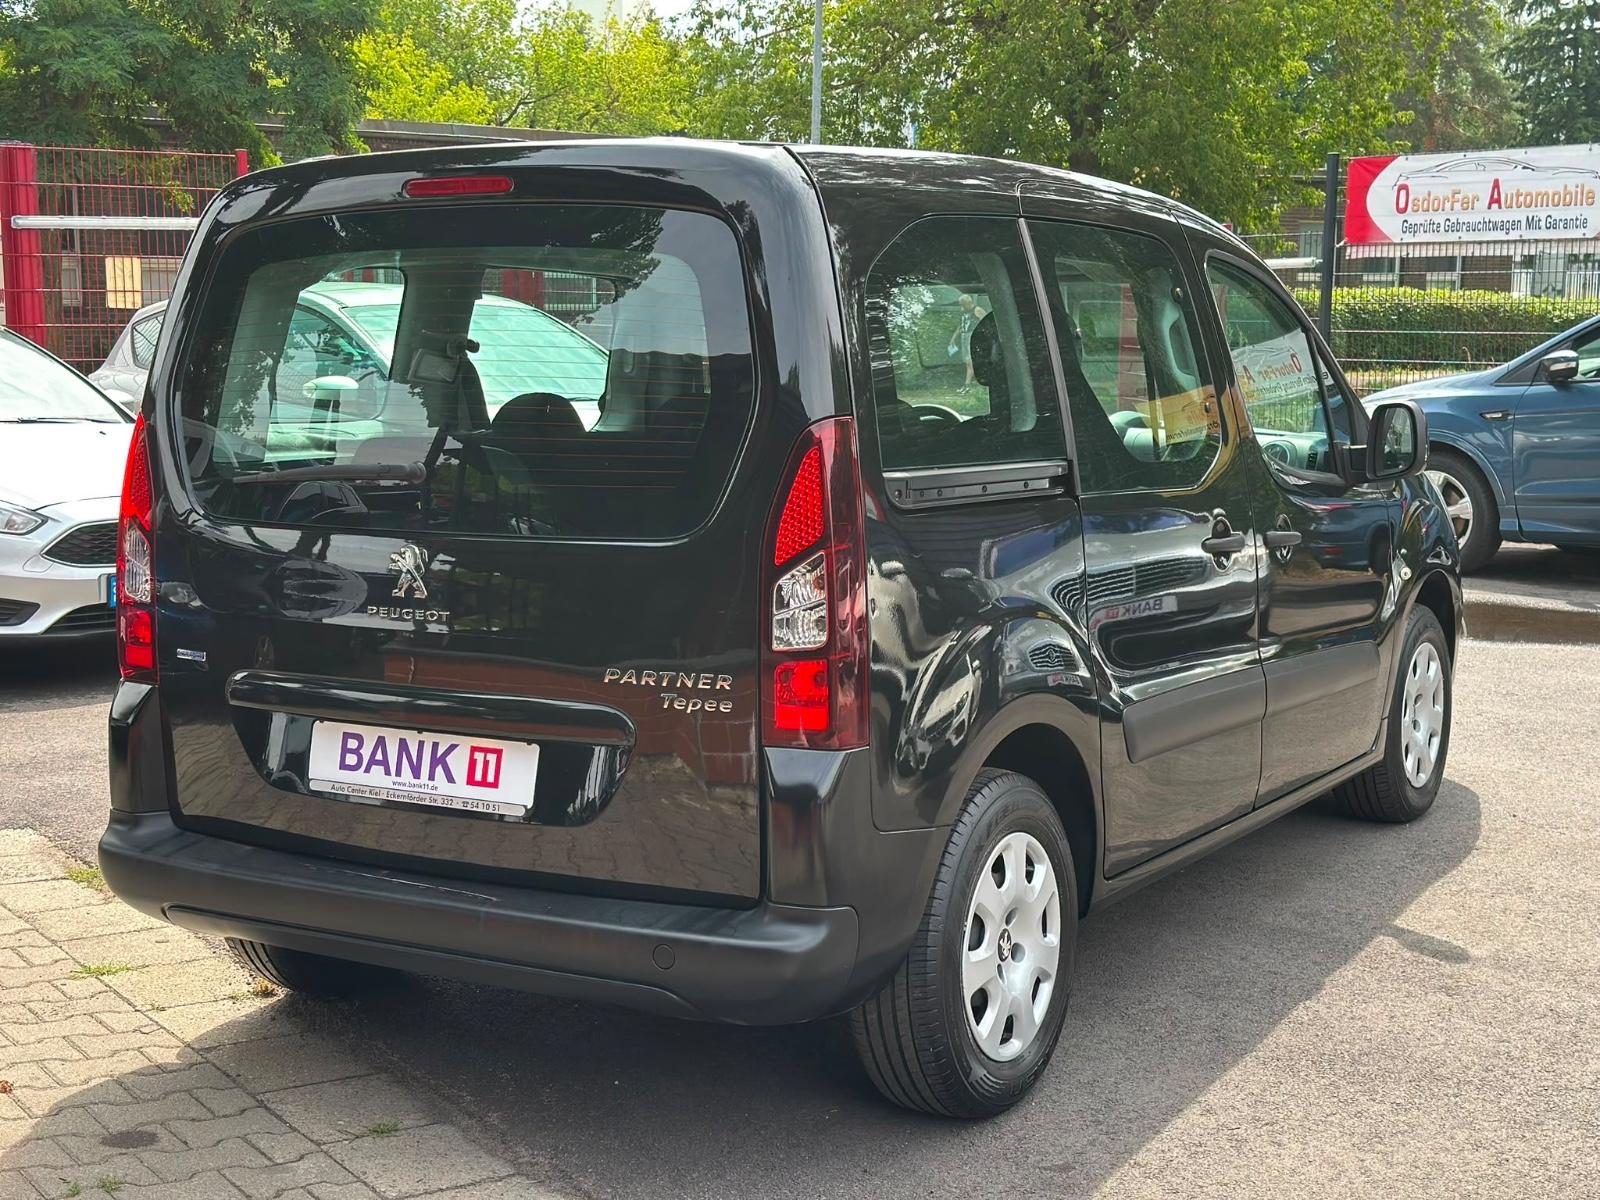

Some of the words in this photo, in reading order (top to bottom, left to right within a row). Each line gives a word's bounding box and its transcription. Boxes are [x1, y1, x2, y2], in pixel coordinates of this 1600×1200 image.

[1395, 183, 1480, 214] OsdorFer
[1487, 178, 1595, 210] Automobile
[1401, 218, 1441, 238] Geprüfte
[1443, 216, 1522, 236] Gebrauchtwagen
[1525, 214, 1542, 231] Mit
[1544, 213, 1588, 231] Garantie
[367, 605, 450, 622] PEUGEOT
[603, 668, 733, 690] PARTNER
[660, 693, 733, 714] Tepee
[338, 731, 460, 784] BANK
[471, 749, 500, 785] 11
[330, 784, 346, 793] Auto
[346, 786, 367, 795] Center
[368, 788, 381, 797] Kiel
[386, 791, 428, 803] Eckernförder
[428, 796, 439, 805] Str.
[440, 797, 454, 807] 332
[391, 780, 439, 791] www.bank11.de
